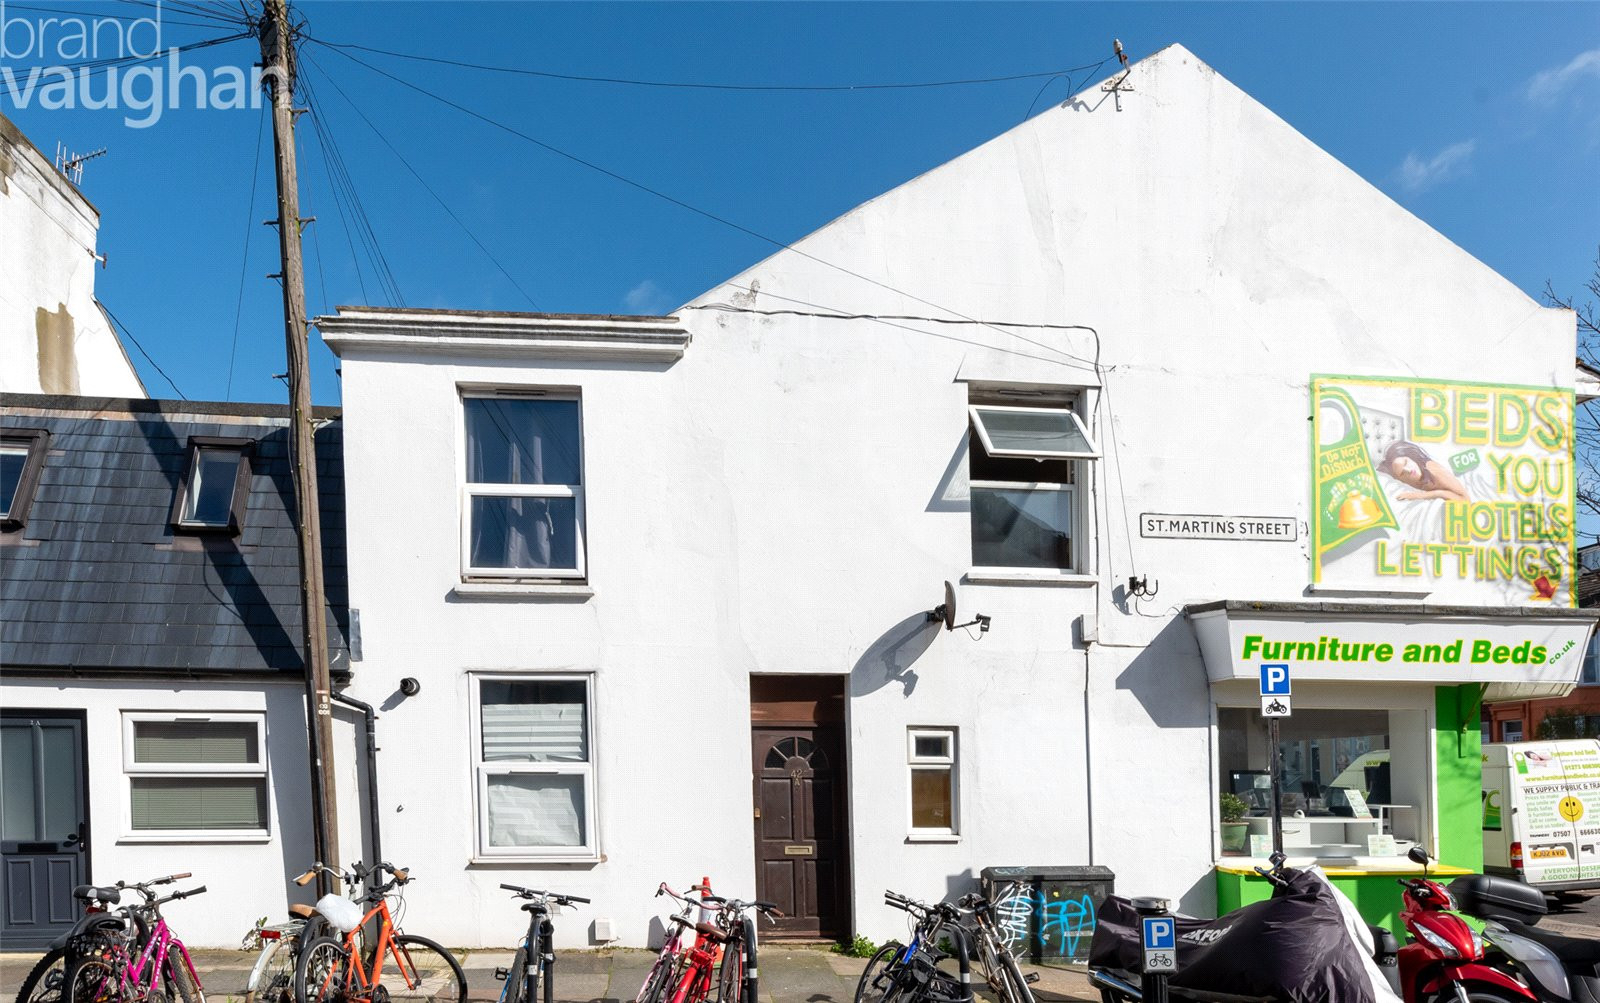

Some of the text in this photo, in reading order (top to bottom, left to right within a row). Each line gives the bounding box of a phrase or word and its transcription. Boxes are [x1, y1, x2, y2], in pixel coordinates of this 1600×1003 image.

[1410, 387, 1566, 451] BEDS
[1453, 453, 1478, 467] FOR
[1486, 452, 1564, 498] YOU
[1239, 522, 1291, 535] STREET
[1445, 501, 1569, 543] HOTELS
[1376, 540, 1564, 581] LETTINGS
[1241, 635, 1394, 663] Furniture
[1402, 639, 1463, 664] and
[1470, 640, 1548, 665] Beds
[1267, 668, 1285, 691] P
[790, 769, 803, 778] 42
[1535, 785, 1559, 794] SUPPLY
[1560, 783, 1582, 792] PUBLIC
[1553, 830, 1571, 838] 07507
[1569, 872, 1594, 880] NIGHTS
[1151, 921, 1170, 946] P
